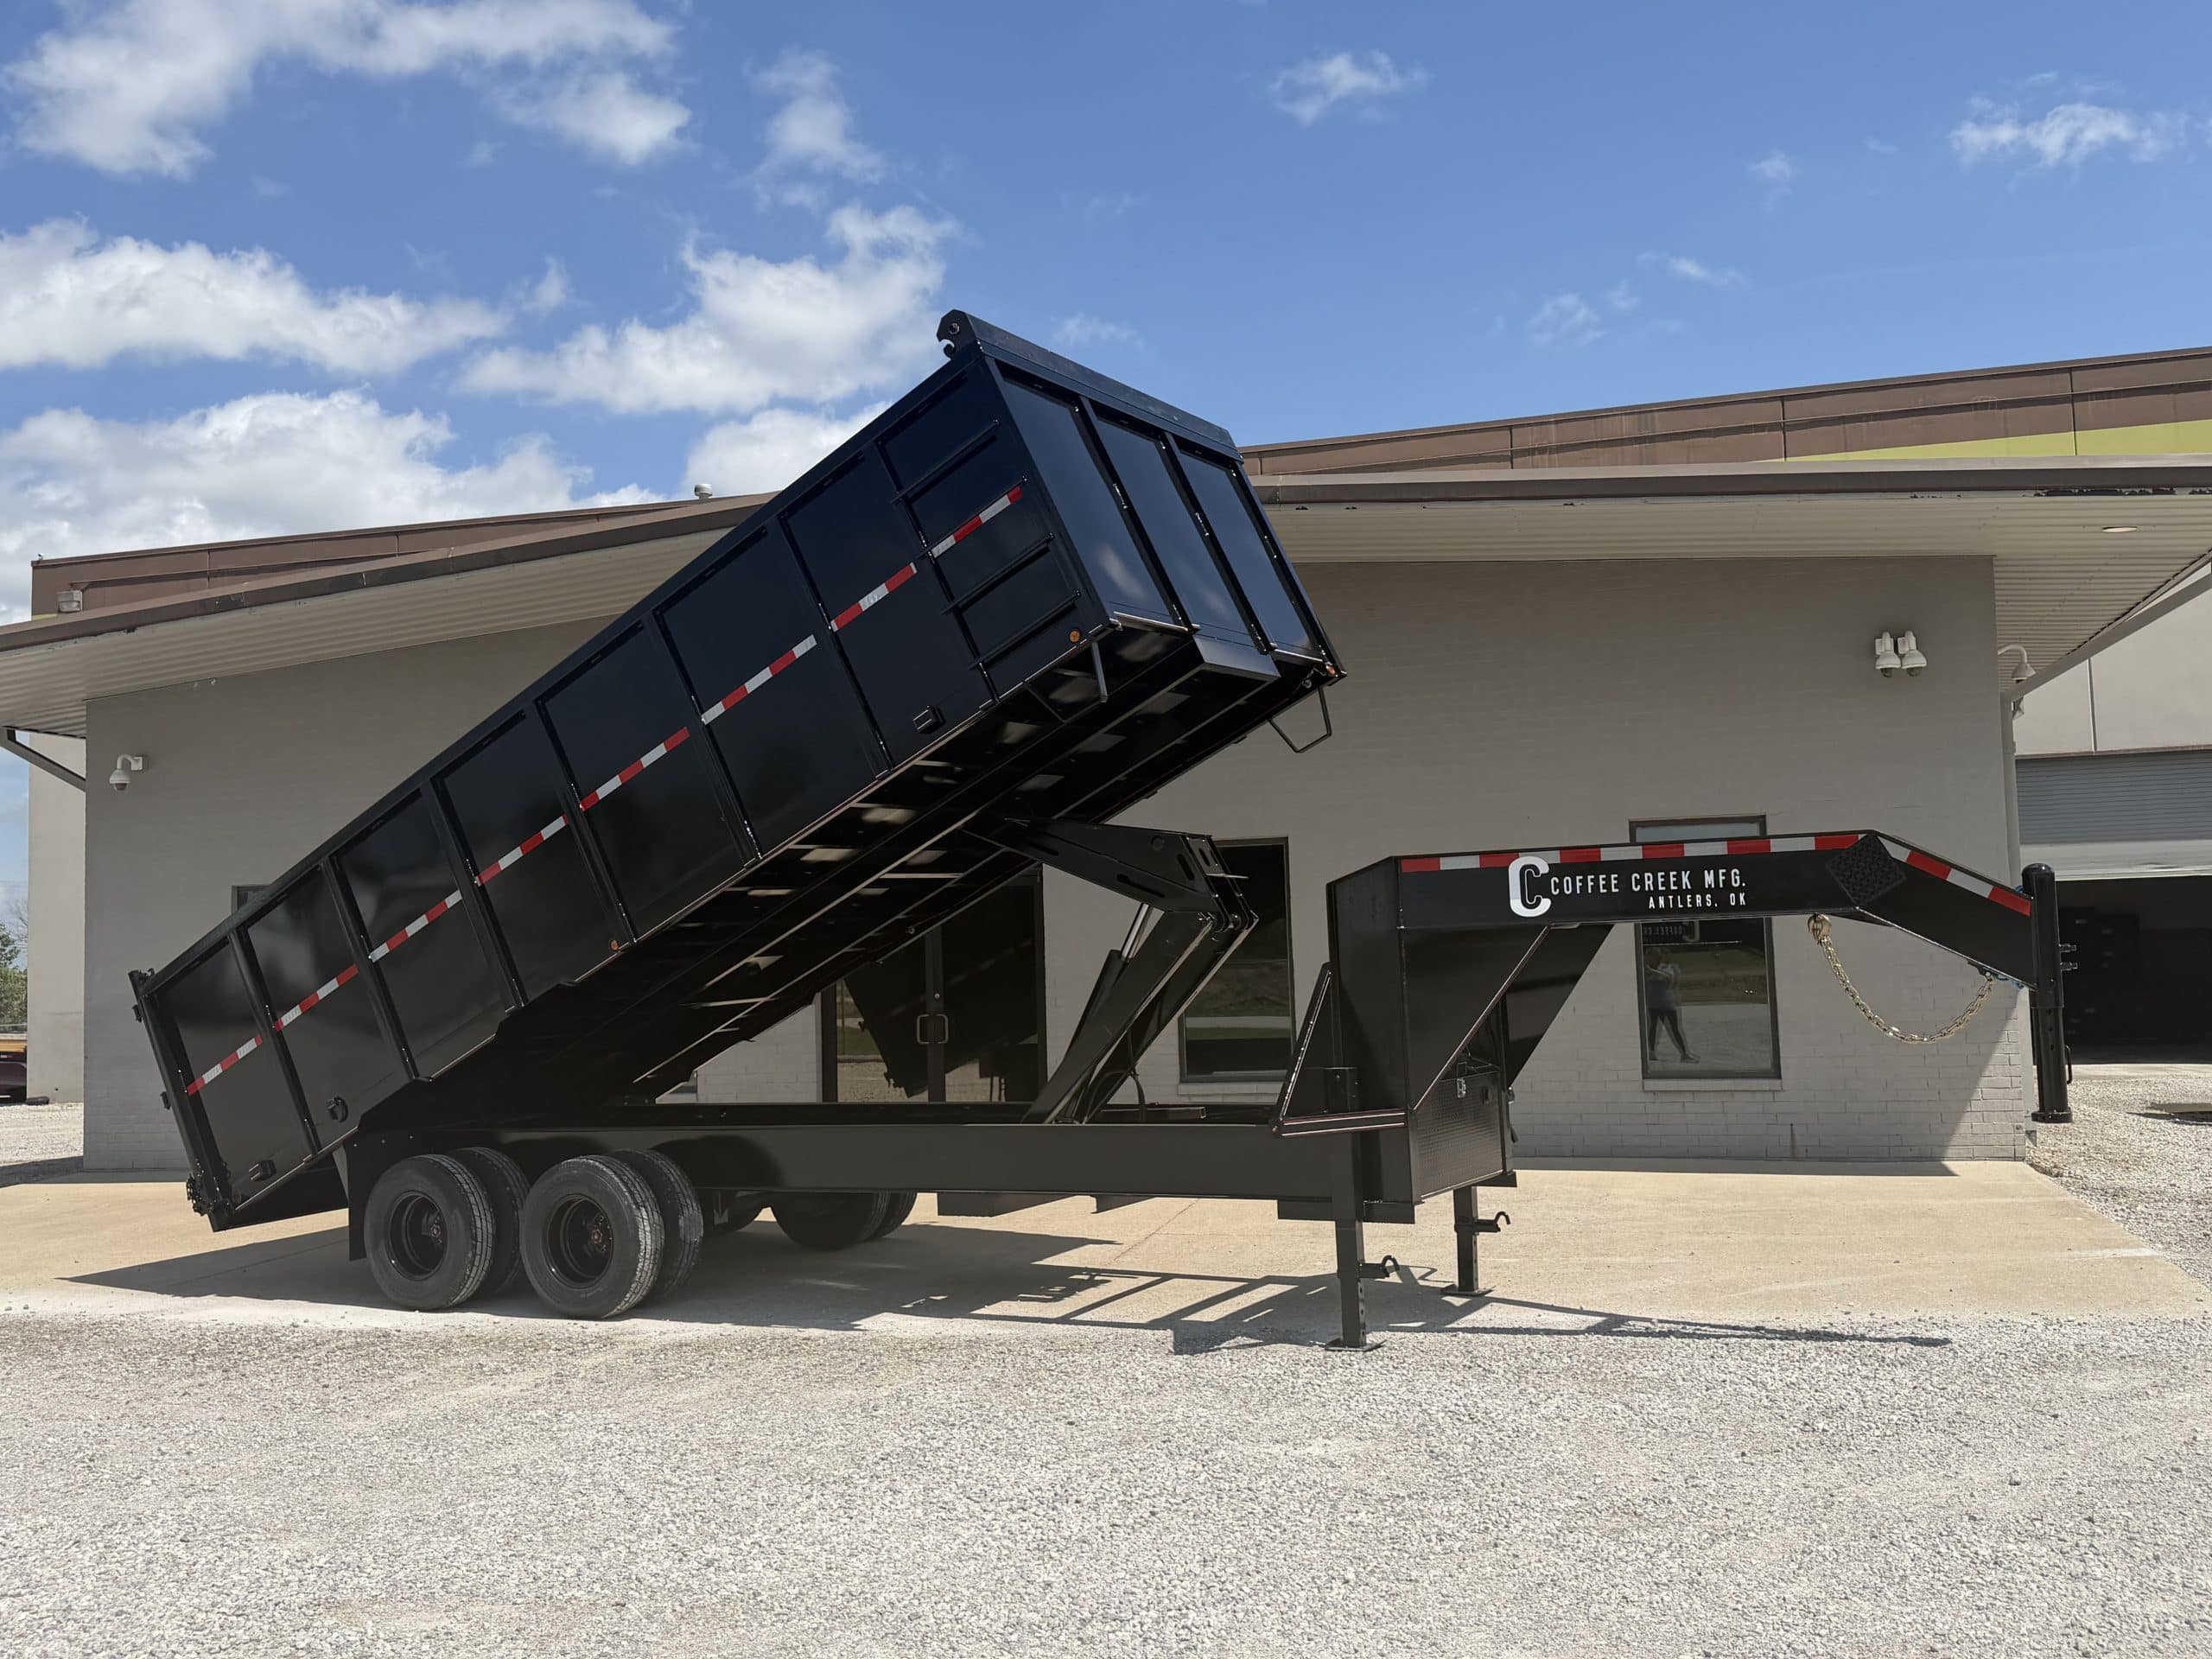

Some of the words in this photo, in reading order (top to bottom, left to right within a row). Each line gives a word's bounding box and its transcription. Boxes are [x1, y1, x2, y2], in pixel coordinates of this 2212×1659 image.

[1550, 874, 1619, 895] COFFEE
[1631, 870, 1692, 892] CREEK
[1704, 868, 1746, 889] MFG.
[1729, 892, 1746, 906] OK
